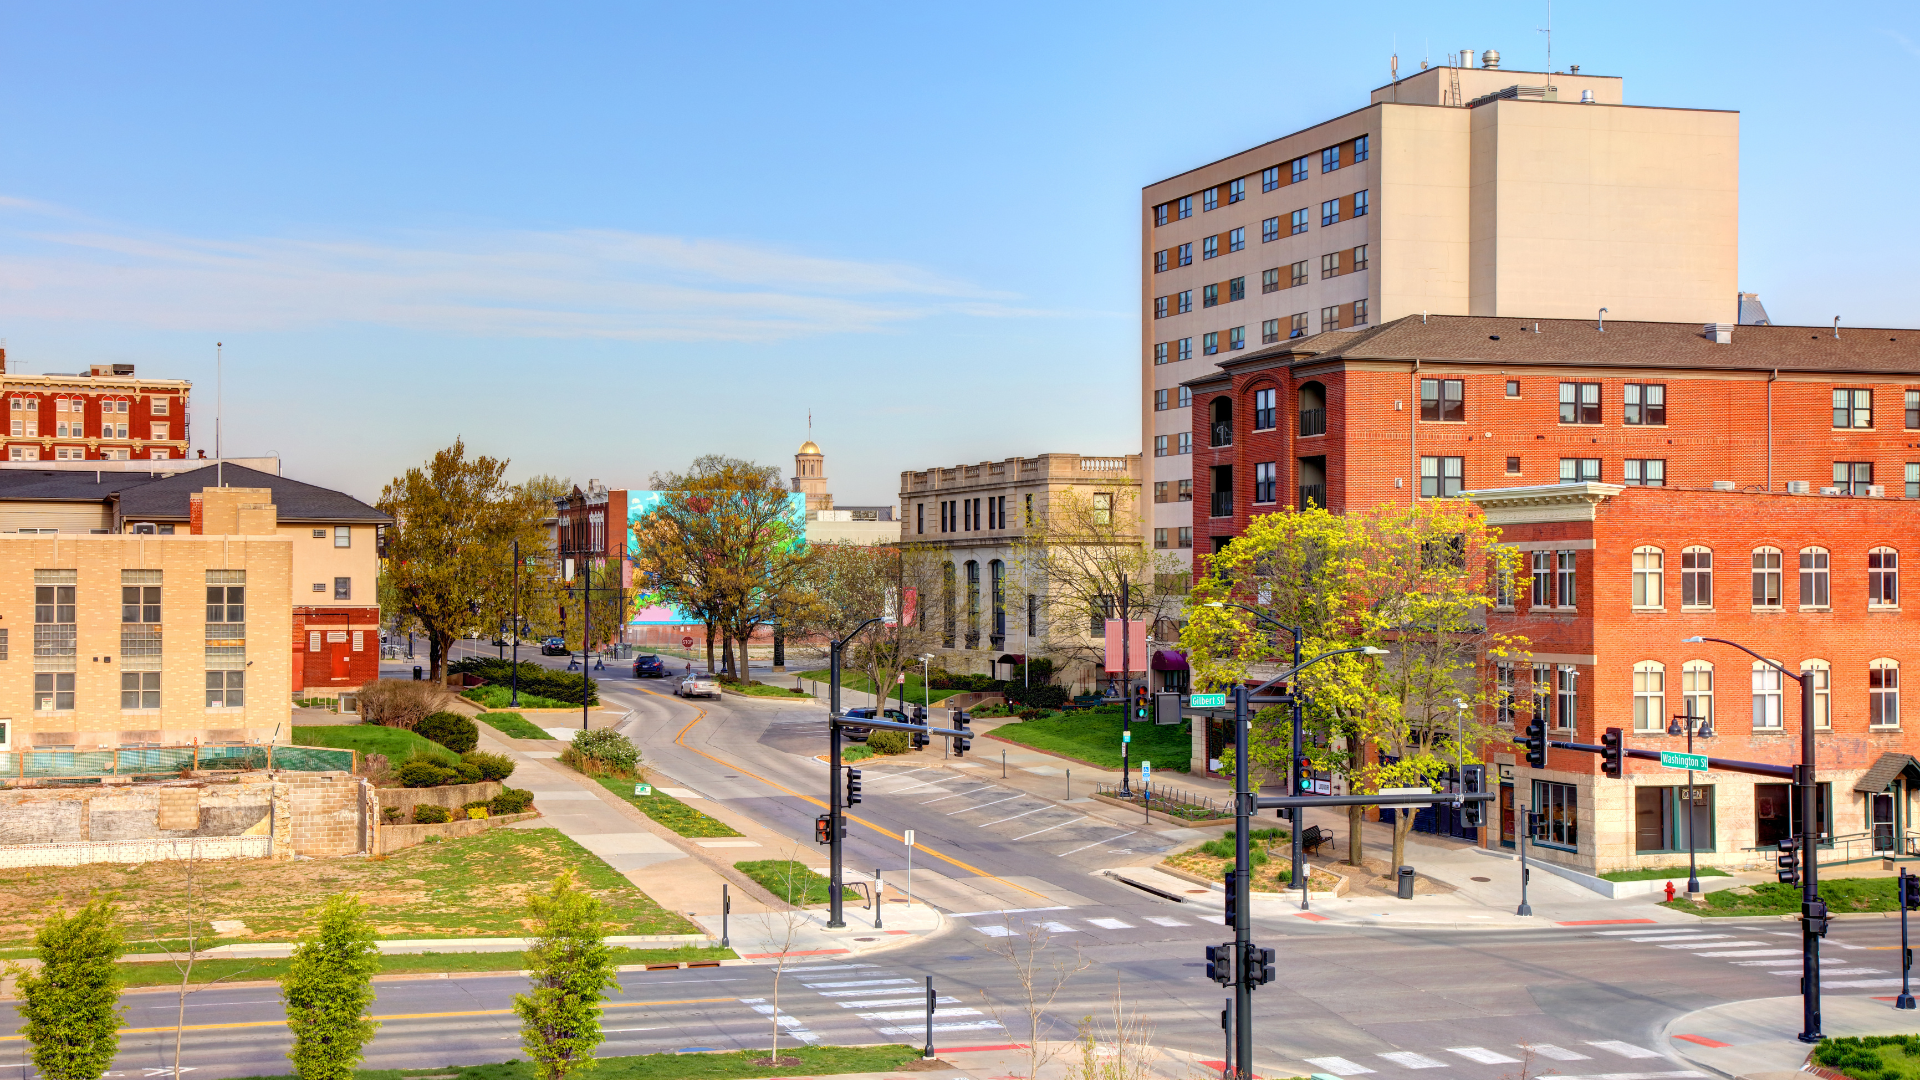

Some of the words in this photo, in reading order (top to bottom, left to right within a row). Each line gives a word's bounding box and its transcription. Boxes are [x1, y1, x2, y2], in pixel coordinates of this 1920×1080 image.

[1192, 696, 1215, 705] Gilbert
[1217, 696, 1224, 705] St
[1663, 754, 1698, 768] Washington
[1701, 758, 1707, 768] St
